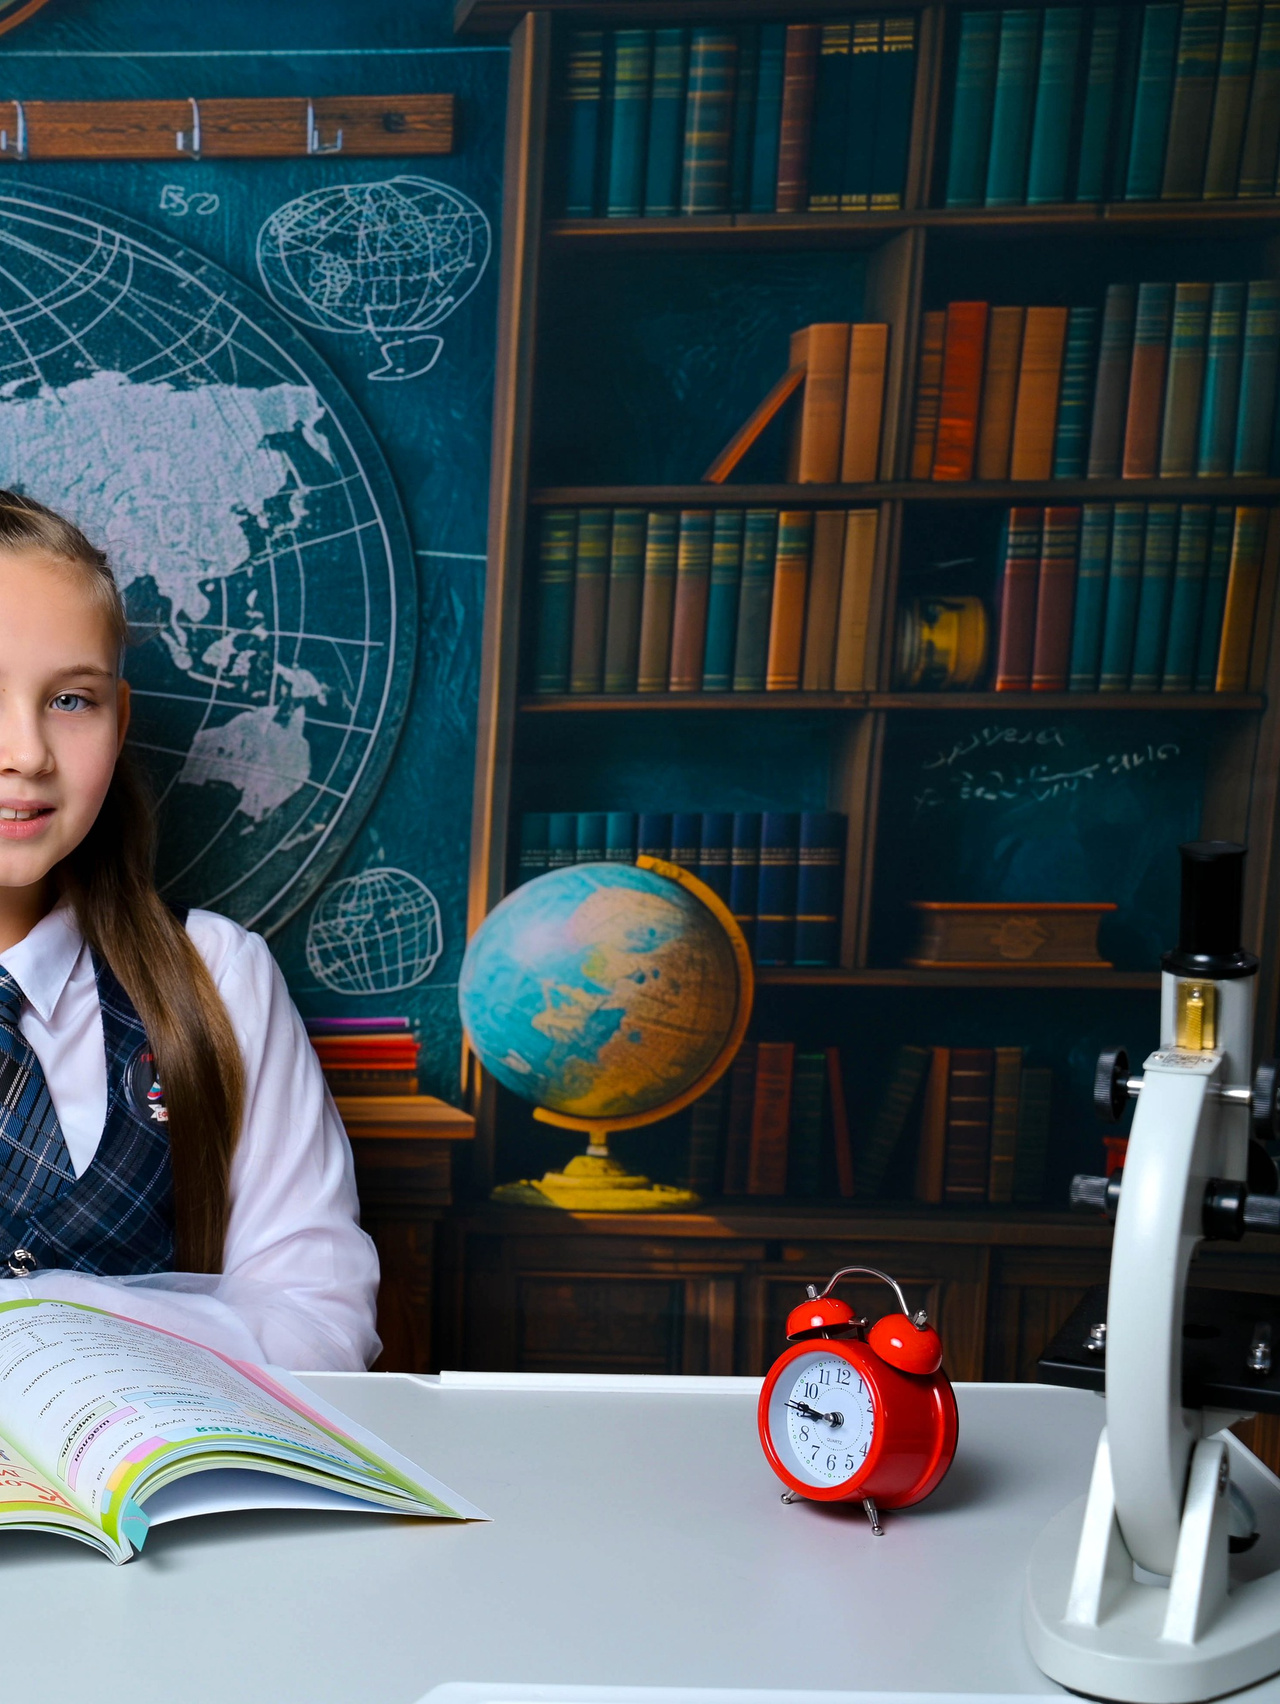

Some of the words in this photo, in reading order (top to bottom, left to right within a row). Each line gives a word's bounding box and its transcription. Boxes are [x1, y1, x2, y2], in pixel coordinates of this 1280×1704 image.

[22, 1357, 76, 1397] изготовить:
[818, 1368, 831, 1386] 11
[836, 1367, 851, 1386] 12
[111, 1385, 140, 1394] надо
[804, 1382, 819, 1400] 10
[856, 1378, 864, 1394] 1
[61, 1395, 106, 1432] начинать:
[61, 1412, 96, 1458] циркуль
[74, 1419, 110, 1462] шаблон
[798, 1425, 811, 1442] 8
[826, 1436, 843, 1446] QUARTZ
[108, 1431, 144, 1460] Ответь
[811, 1444, 821, 1461] 7
[858, 1441, 869, 1458] 4
[826, 1454, 837, 1471] 6
[844, 1454, 855, 1471] 5
[96, 1466, 106, 1481] на
